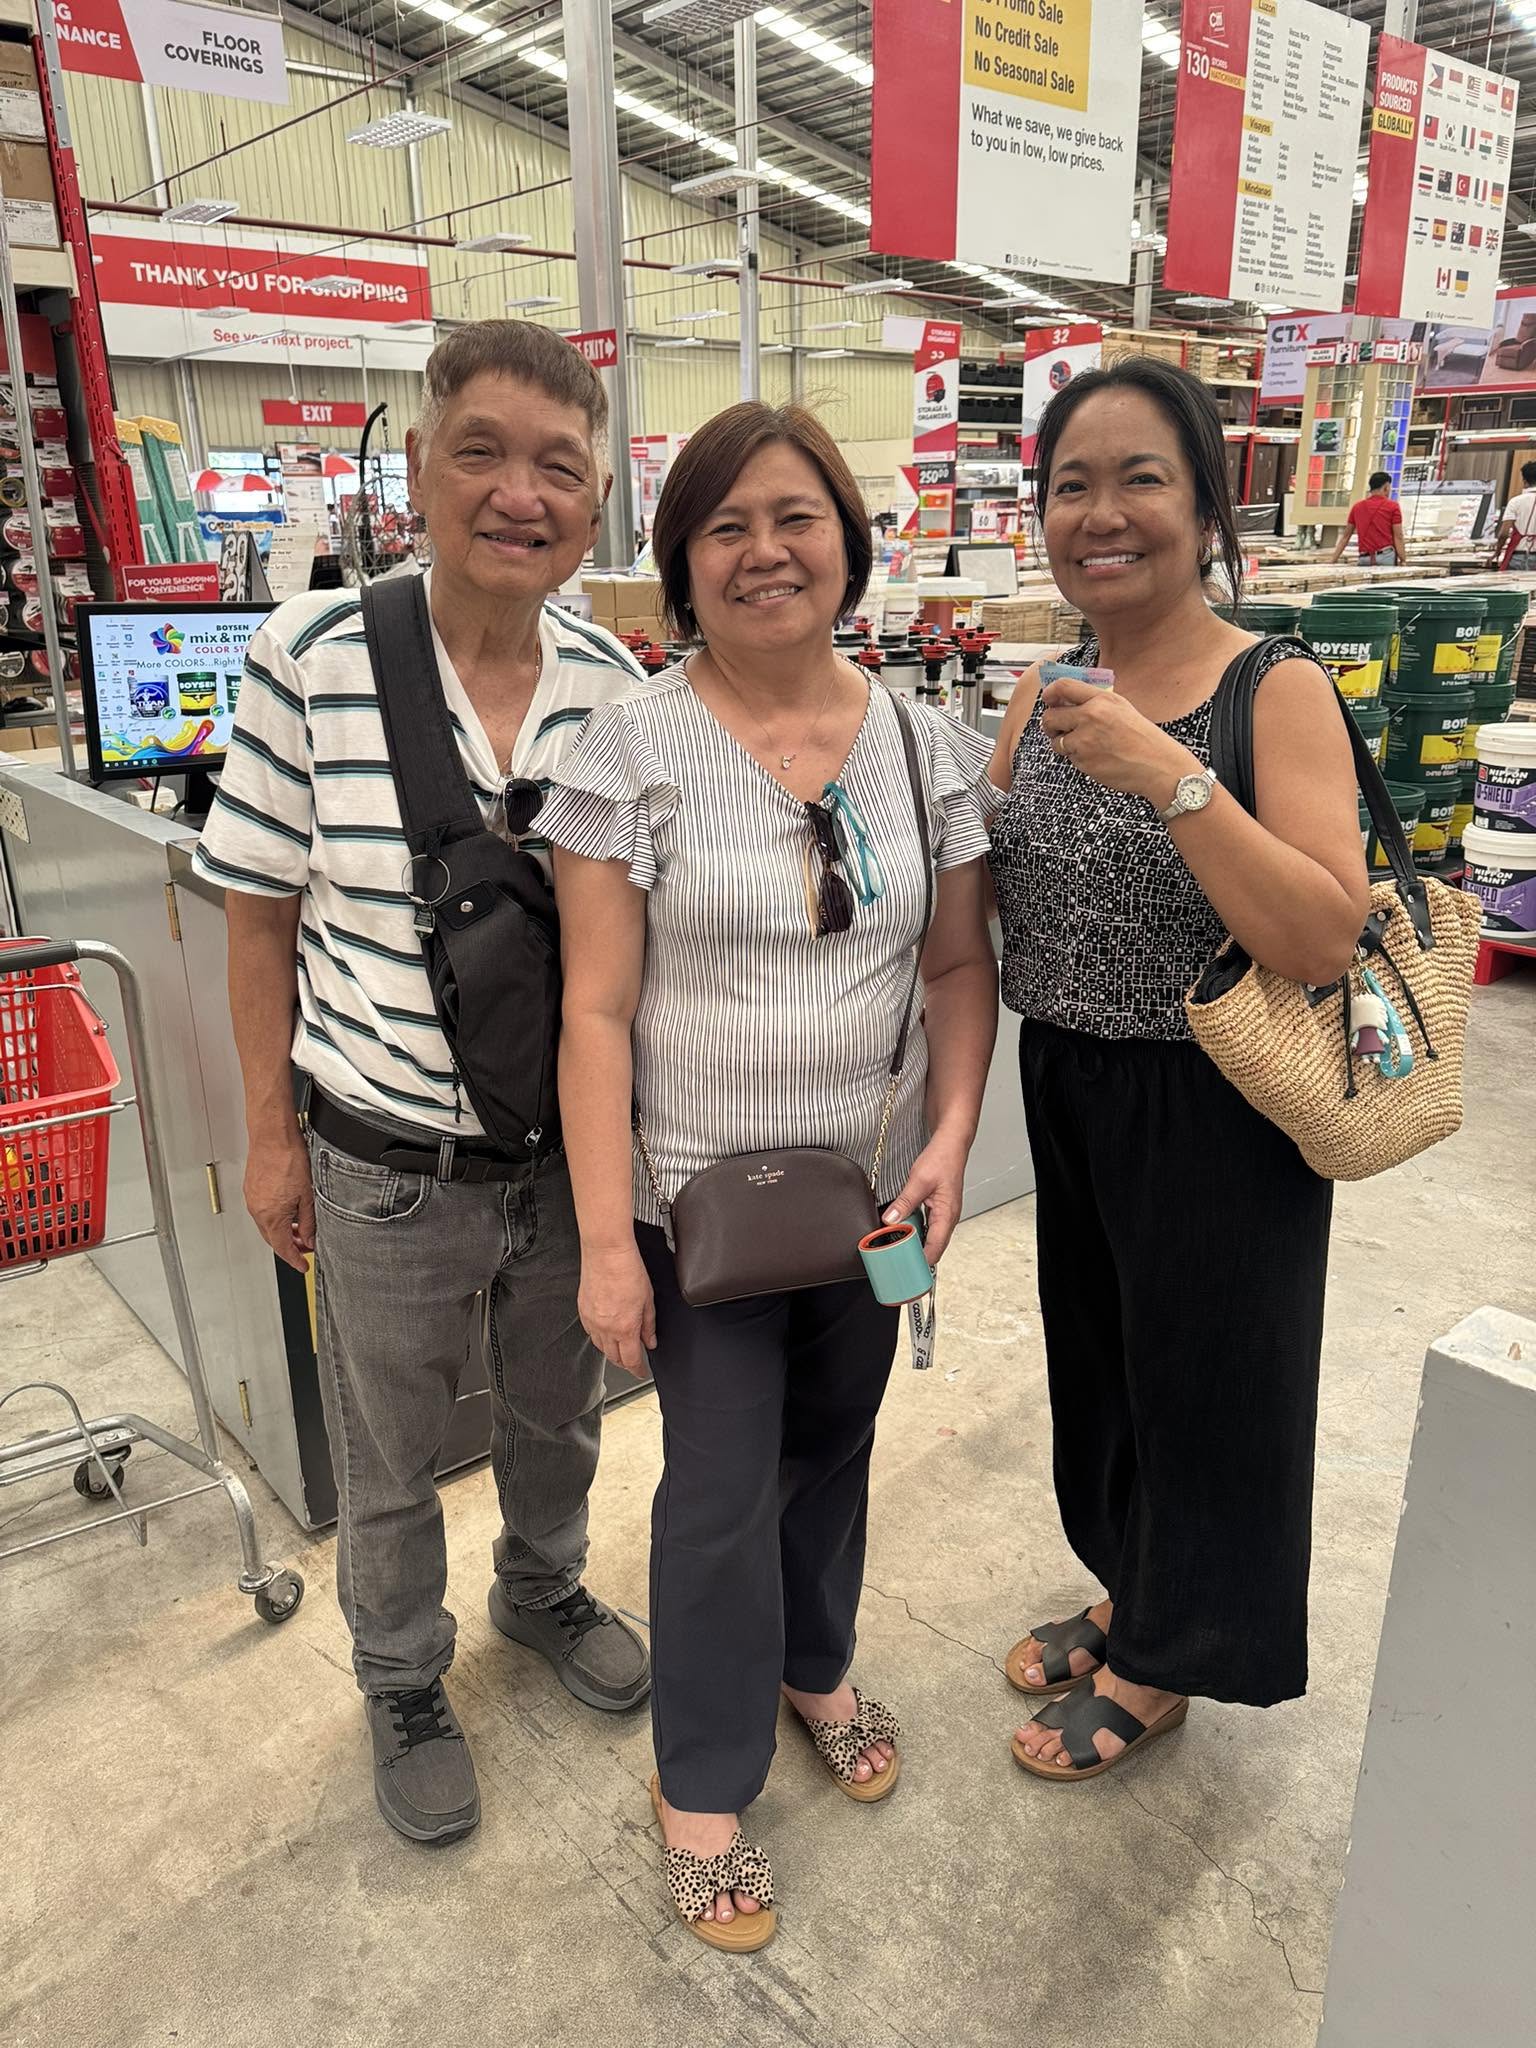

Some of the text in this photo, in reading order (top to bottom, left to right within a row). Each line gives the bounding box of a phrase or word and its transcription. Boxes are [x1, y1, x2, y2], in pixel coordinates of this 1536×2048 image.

[1039, 0, 1064, 24] Sale
[202, 31, 261, 55] FLOOR
[975, 15, 1059, 57] No Credit Sale
[164, 43, 264, 74] COVERINGS
[1186, 49, 1209, 79] 130
[975, 50, 1074, 94] No Seasonal Sale
[1382, 72, 1417, 95] PRODUCTS
[1380, 92, 1412, 112] SOURCED
[972, 103, 1123, 152] What we save, we give back
[1250, 119, 1270, 133] Visayas
[1378, 114, 1413, 134] GLOBALLY
[971, 130, 1105, 171] to you in low, low prices.
[130, 263, 207, 286] THANK
[213, 269, 258, 291] YOU
[265, 275, 306, 294] FOR
[213, 329, 240, 343] See
[273, 334, 301, 346] next
[305, 335, 353, 350] project.
[1052, 329, 1070, 344] 32
[1272, 323, 1310, 342] CTX
[585, 337, 604, 360] EXIT
[1270, 345, 1306, 354] furniture
[302, 405, 333, 422] EXIT
[918, 406, 942, 414] STORAGE
[918, 412, 952, 420] ORGANIZERS
[147, 577, 172, 585] YOUR
[173, 575, 216, 584] SHOPPING
[143, 584, 204, 594] CONVENIENCE
[190, 632, 217, 643] mix
[220, 632, 230, 643] &
[1313, 642, 1372, 655] BOYSEN
[137, 660, 161, 669] More
[1489, 769, 1528, 779] NIPPON
[1492, 776, 1523, 785] PAINT
[1475, 868, 1513, 879] NIPPON
[1477, 876, 1508, 885] PAINT
[764, 1170, 784, 1179] spade
